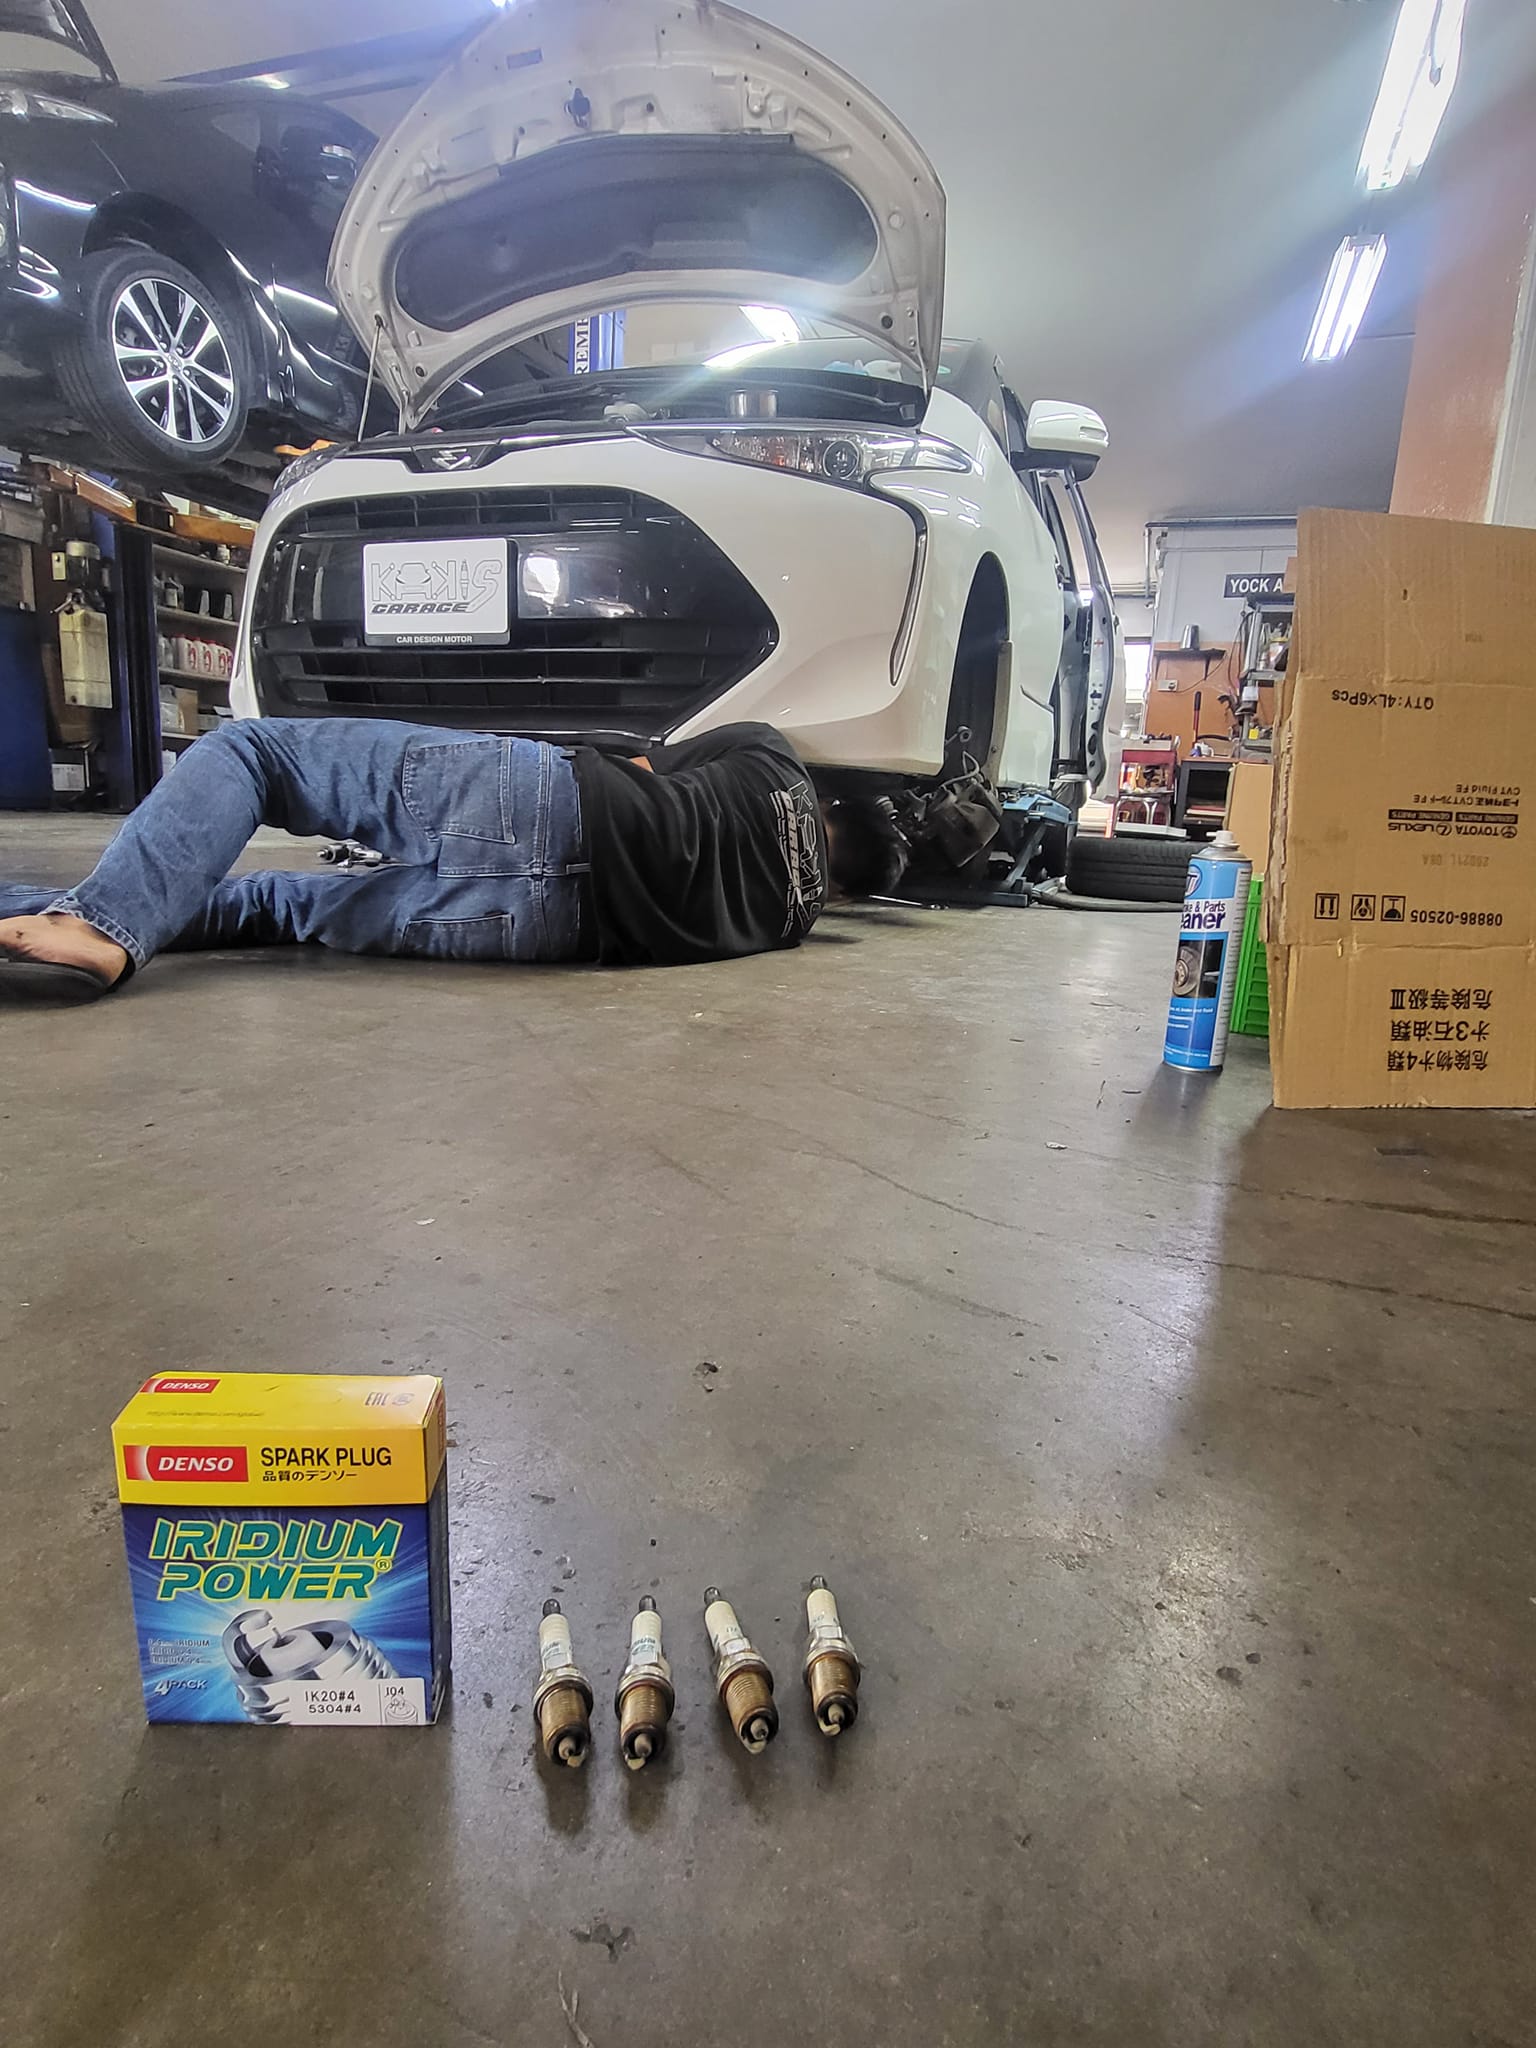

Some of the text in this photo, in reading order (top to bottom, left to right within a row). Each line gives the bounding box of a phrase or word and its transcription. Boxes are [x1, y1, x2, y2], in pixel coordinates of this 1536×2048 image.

[1230, 577, 1270, 593] YOCK
[371, 602, 470, 614] GARAGE
[444, 635, 473, 643] MOTOR
[1456, 785, 1520, 796] CVT Fluid FE
[1412, 794, 1427, 803] FE
[1388, 822, 1434, 832] LEXUS
[1456, 825, 1499, 836] TOYOTA
[1195, 901, 1200, 912] &
[1204, 901, 1226, 912] Parts
[1410, 910, 1503, 927] 08886-02505
[160, 1381, 211, 1391] DENSO
[260, 1447, 392, 1467] SPARK PLUG
[157, 1457, 234, 1472] DENSO
[262, 1470, 358, 1482] 品質のデンソー
[149, 1518, 404, 1560] IRIDIUM
[158, 1562, 381, 1602] POWER
[308, 1704, 361, 1714] 5304#4
